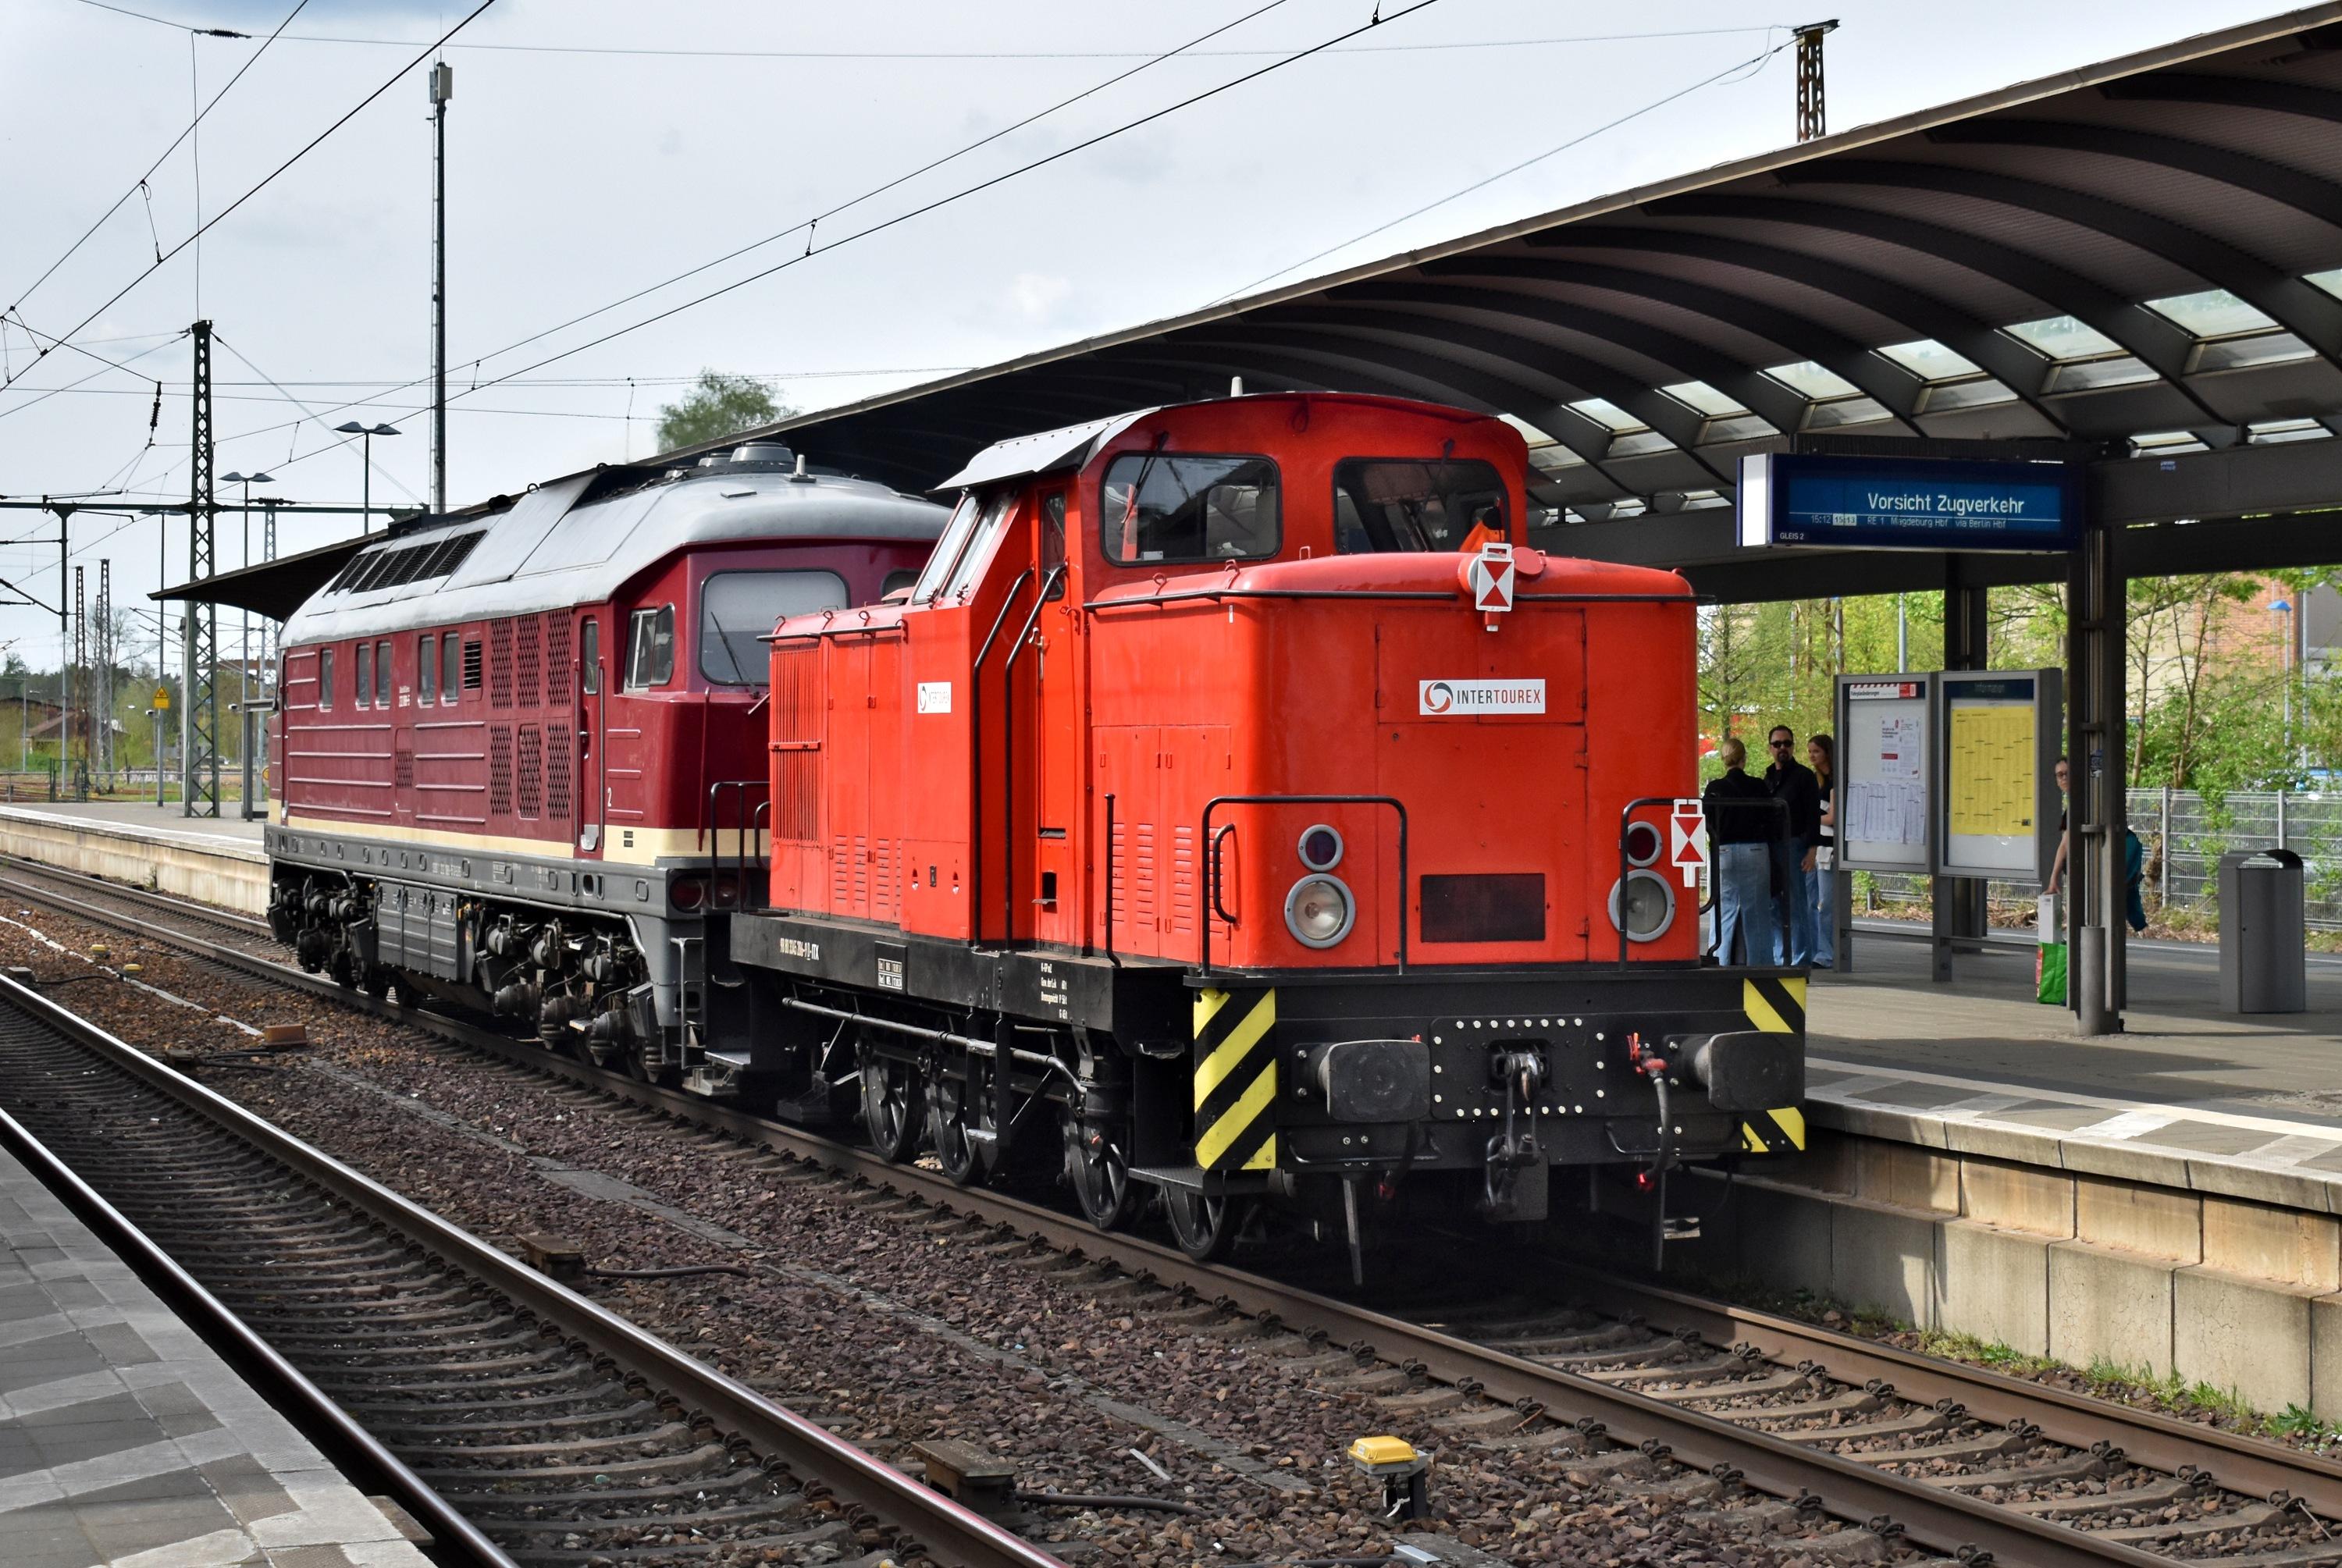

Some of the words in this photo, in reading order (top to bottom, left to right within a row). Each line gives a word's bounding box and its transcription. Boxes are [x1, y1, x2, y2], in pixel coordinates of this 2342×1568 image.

[1867, 492, 1931, 510] Vorsicht
[1937, 495, 2024, 516] Zugverkehr
[1867, 516, 1877, 525] RE
[1890, 517, 1933, 528] Magdeburg
[1935, 518, 1948, 527] Hbf
[1956, 518, 1966, 528] via
[1969, 519, 1991, 528] Berlin
[1993, 520, 2006, 528] Hbf
[1457, 689, 1541, 704] INTERTOUREX
[607, 787, 612, 807] 2
